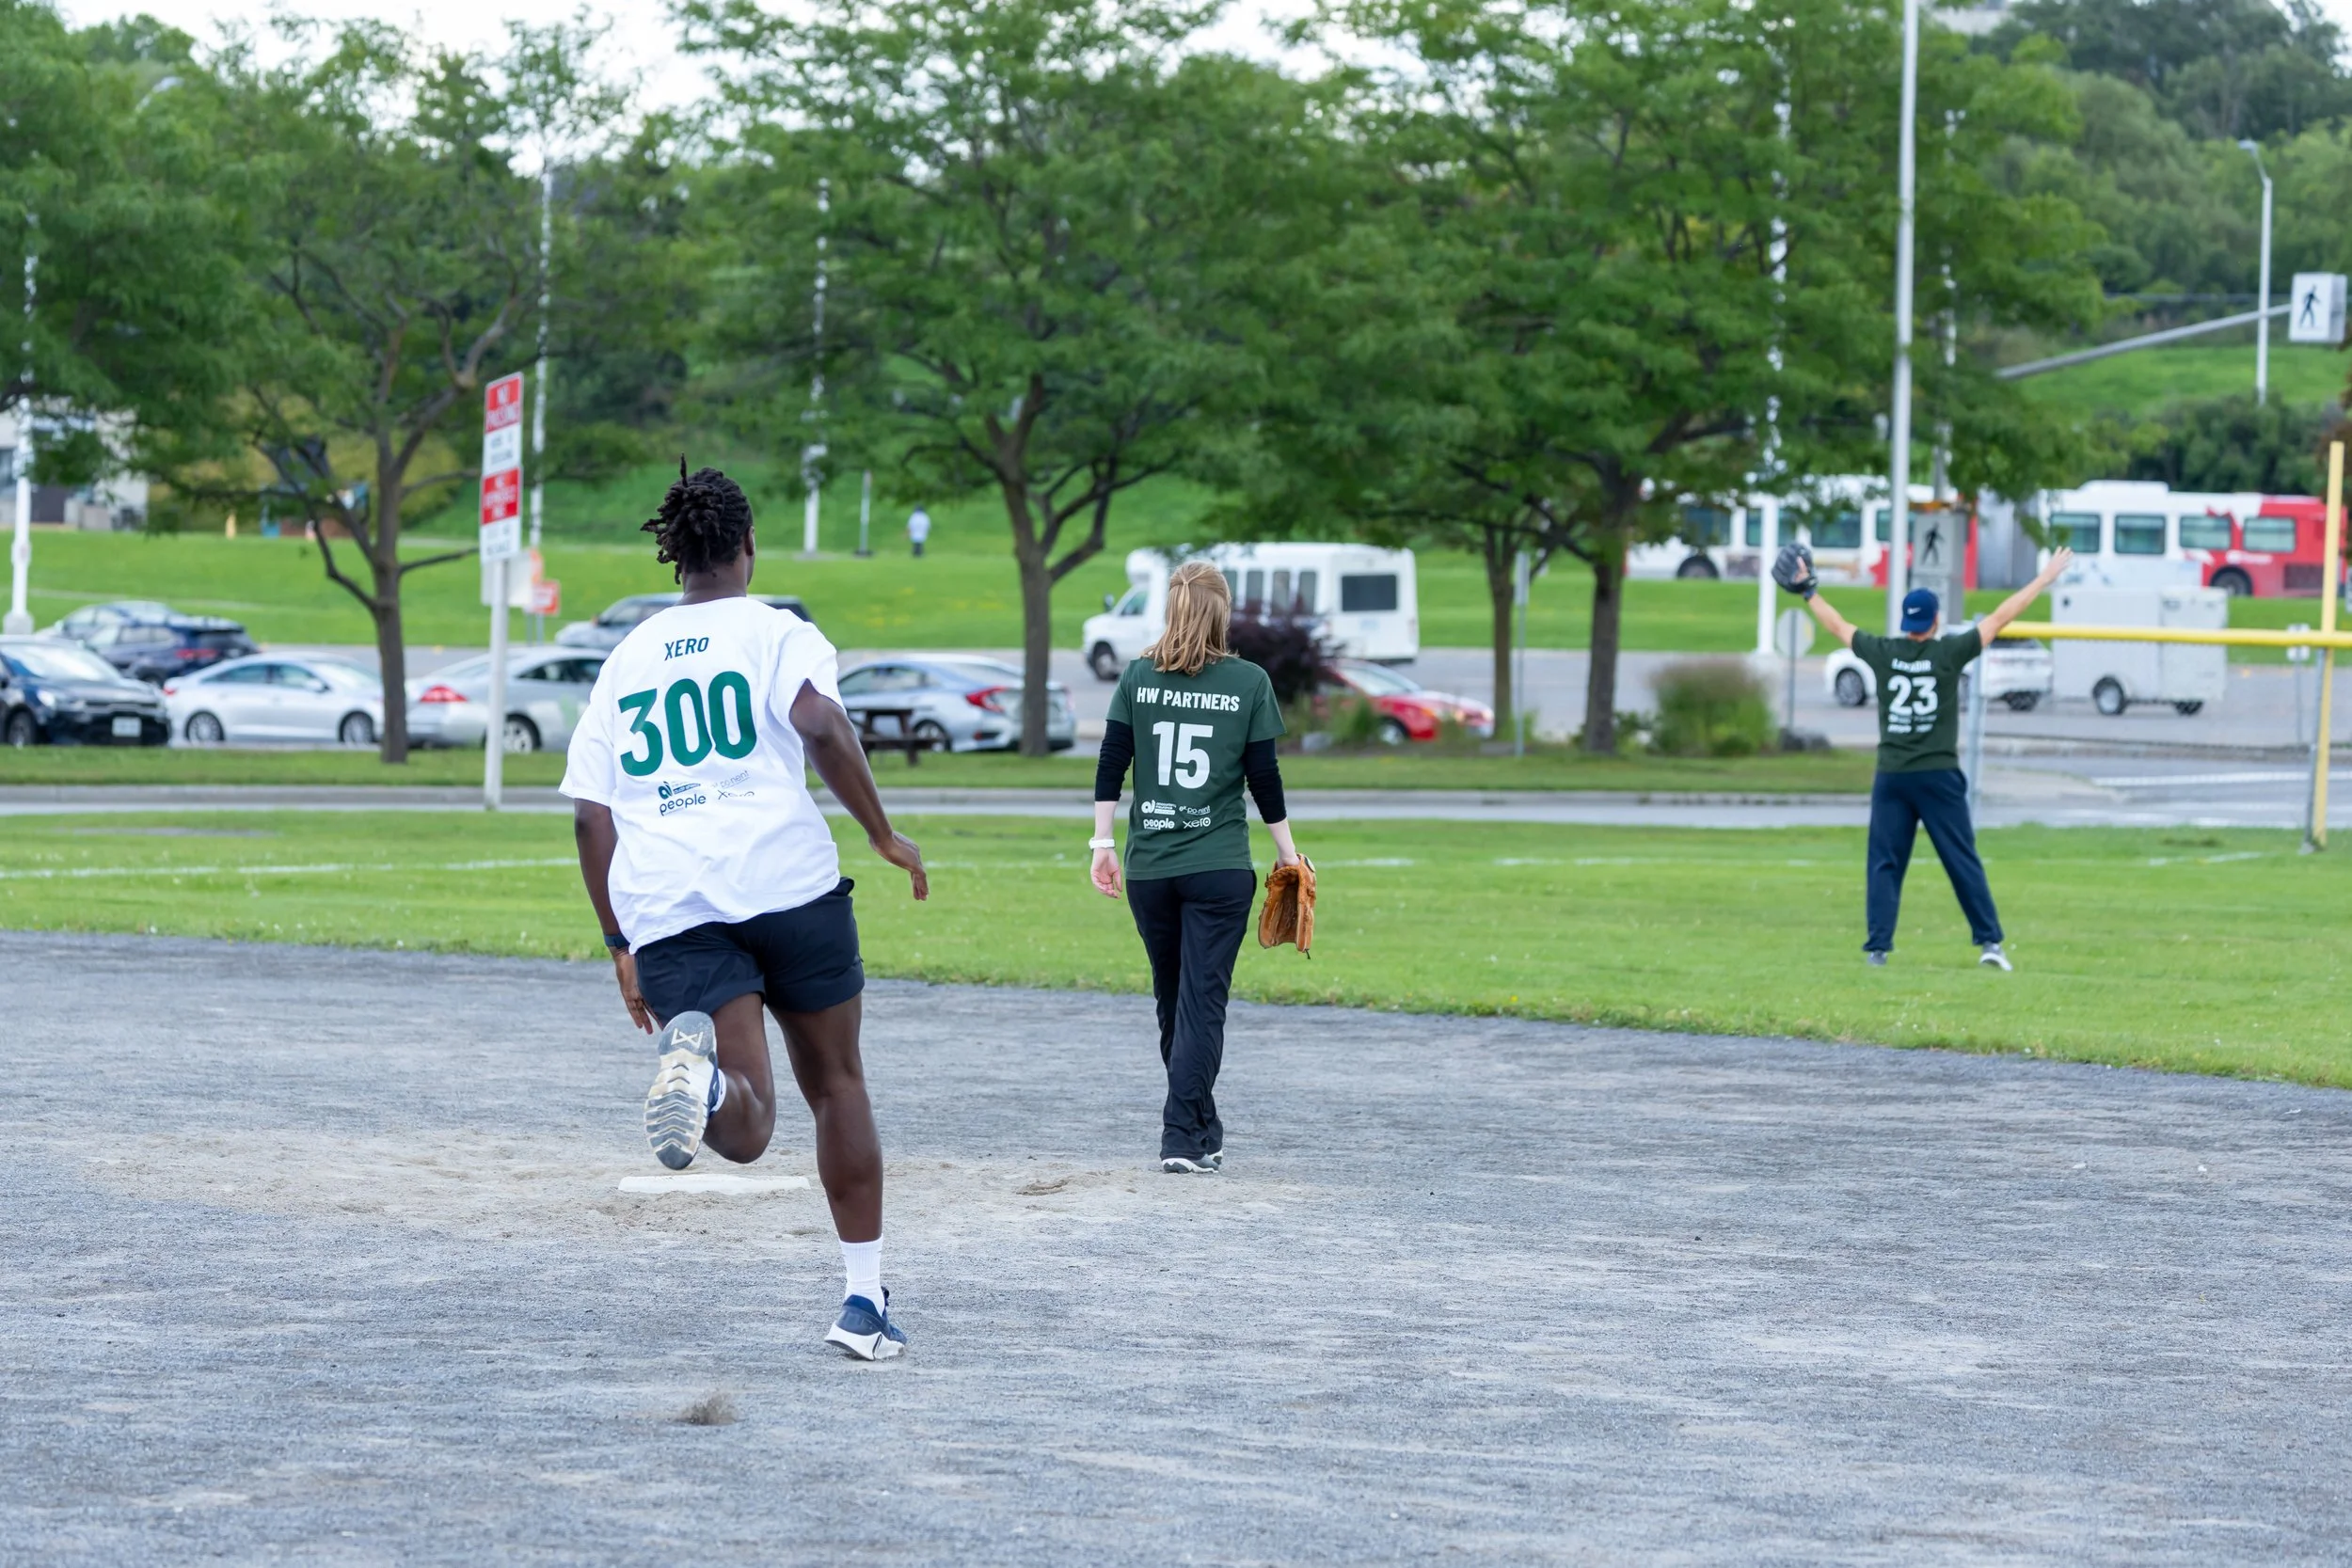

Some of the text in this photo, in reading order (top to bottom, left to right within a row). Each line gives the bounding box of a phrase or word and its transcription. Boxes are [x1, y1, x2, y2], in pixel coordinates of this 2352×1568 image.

[664, 637, 709, 661] XERO
[1136, 687, 1240, 712] HW PARTNERS
[1887, 674, 1938, 716] 23
[618, 671, 757, 777] 300
[1152, 721, 1214, 789] 15
[660, 794, 707, 816] people
[1143, 817, 1175, 831] people
[1183, 816, 1211, 830] xero
